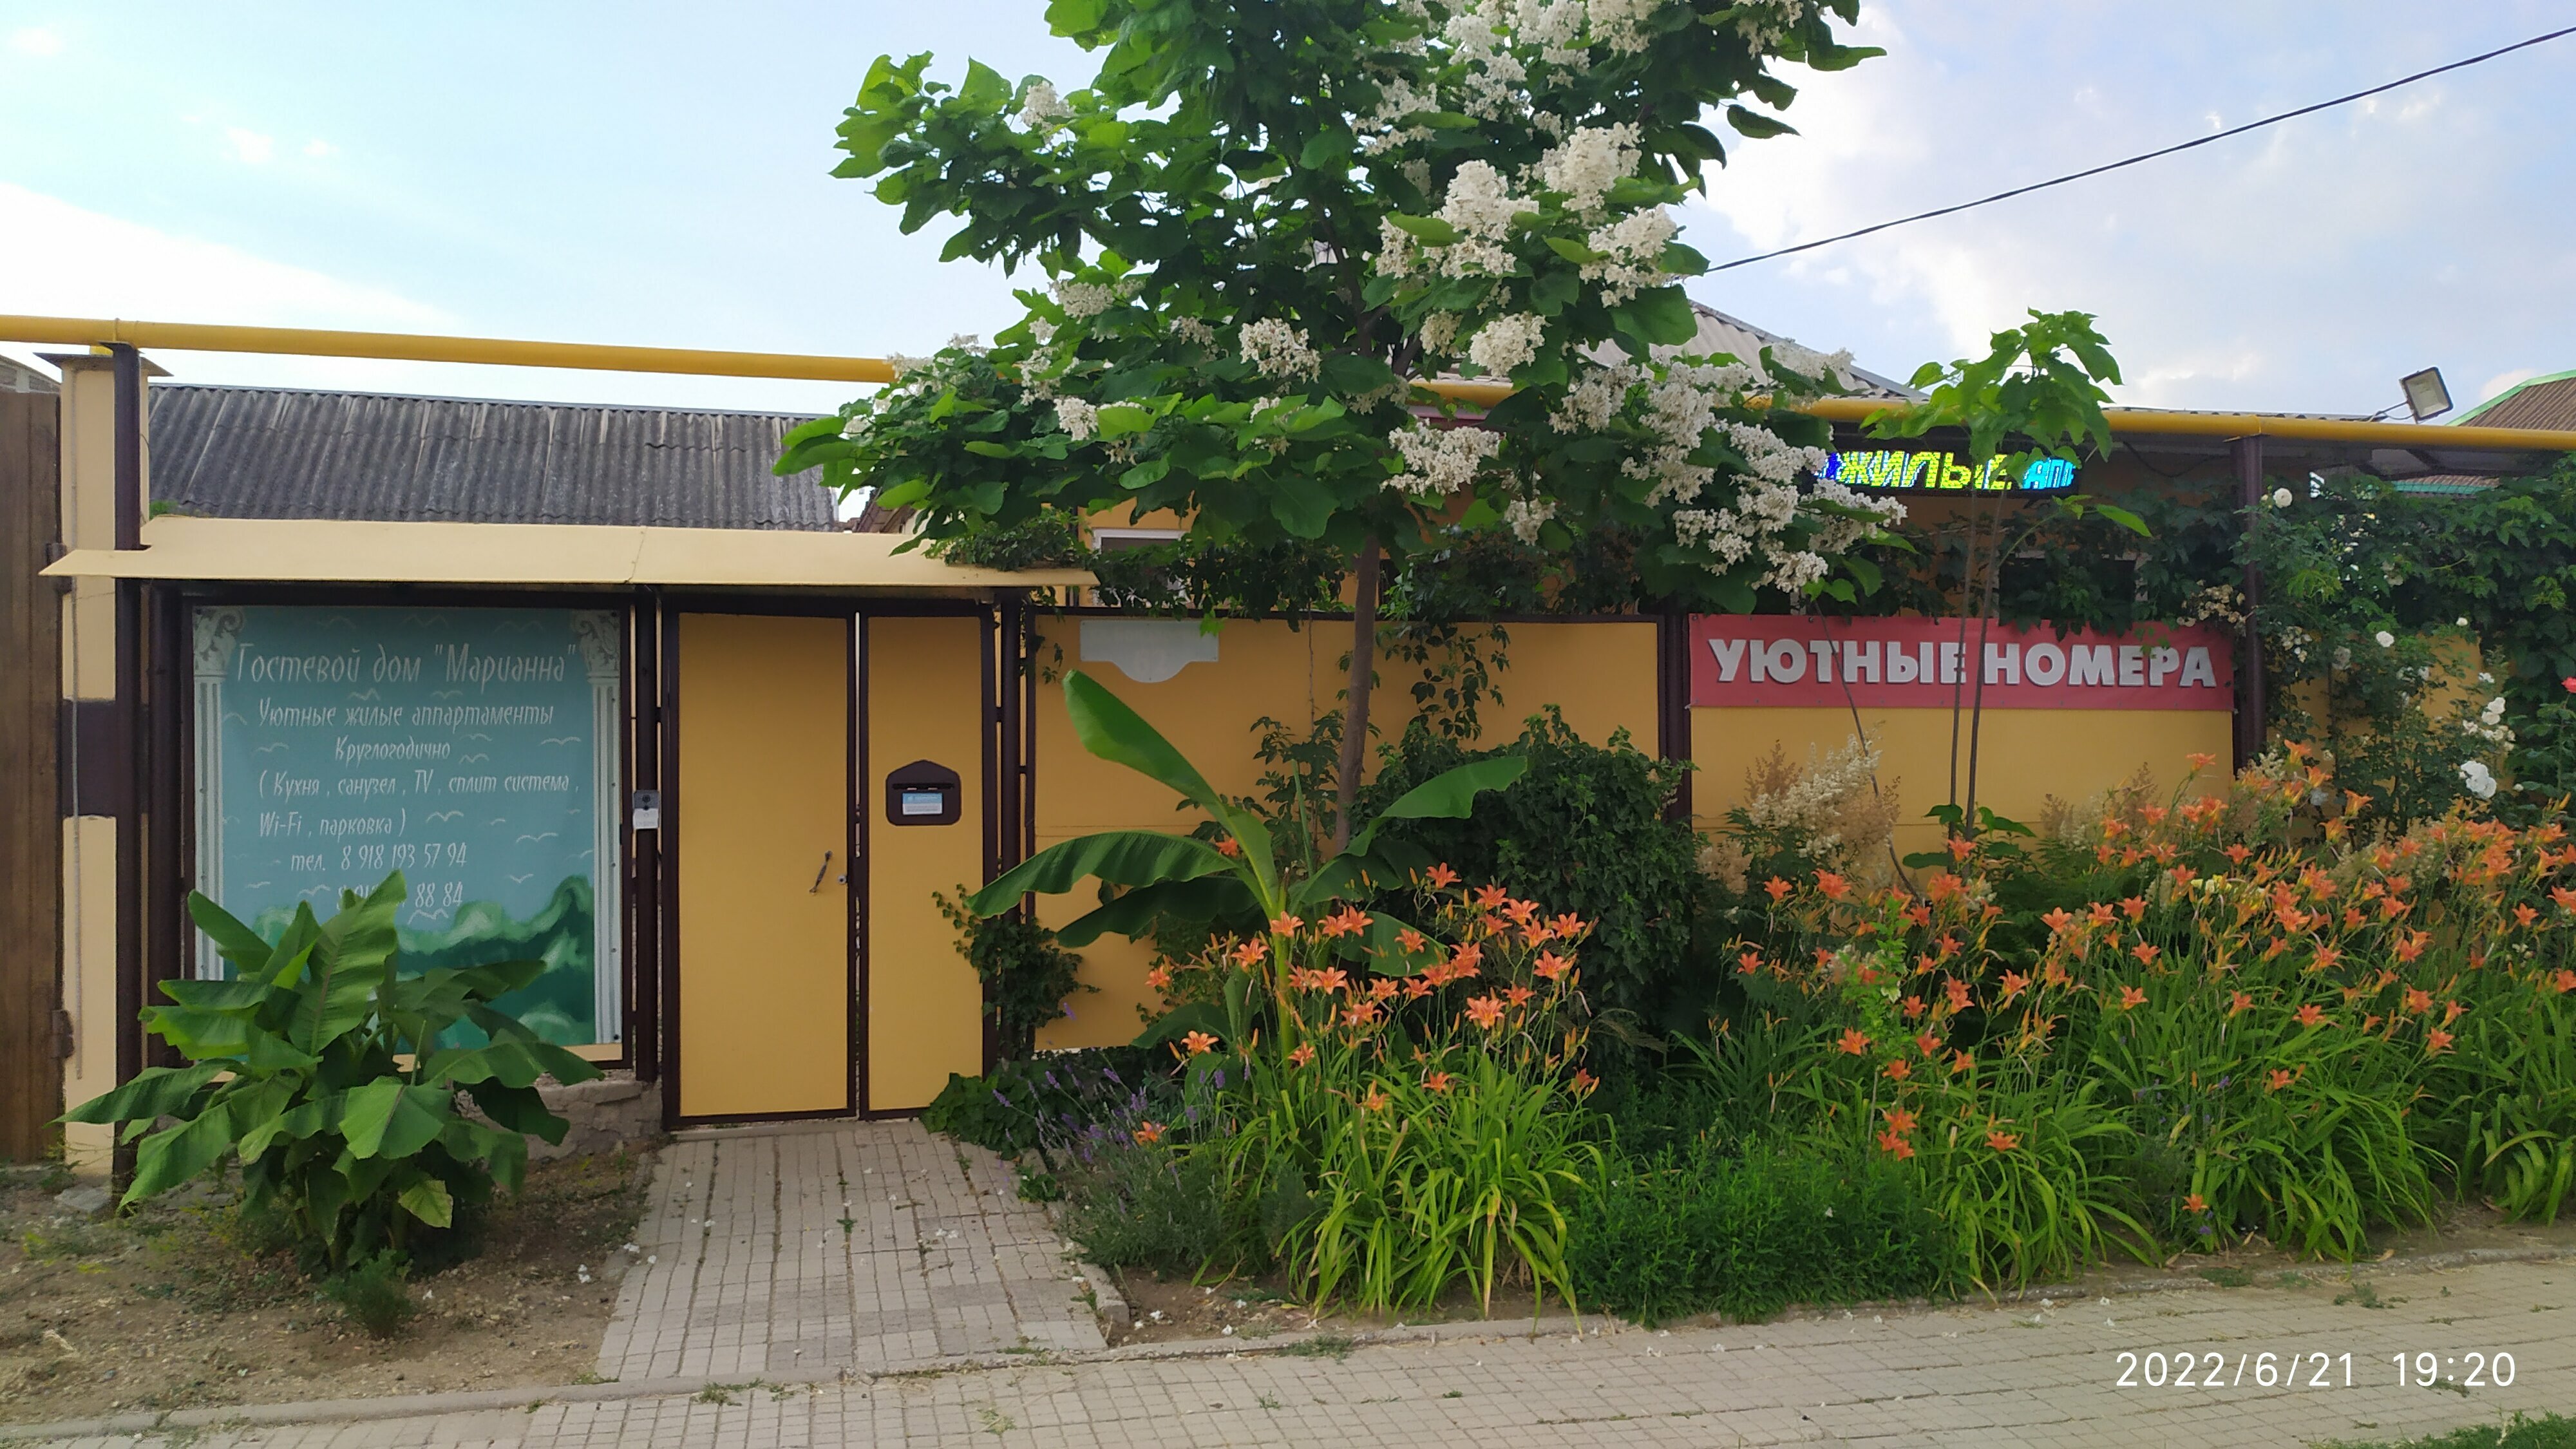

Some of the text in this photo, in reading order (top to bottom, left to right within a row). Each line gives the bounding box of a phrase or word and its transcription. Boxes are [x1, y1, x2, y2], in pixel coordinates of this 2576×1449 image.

[238, 642, 577, 694] Гостевой дом "Марианна"
[1709, 639, 2217, 688] УЮТНЫЕ НОМЕРА
[259, 696, 554, 734] Уютные жилые аппартаменты
[335, 734, 451, 769] Круглогодично
[448, 775, 497, 793] сплит
[290, 841, 468, 871] тел. 8 918 193 57 94
[415, 882, 436, 909] 88
[442, 880, 464, 908] 84
